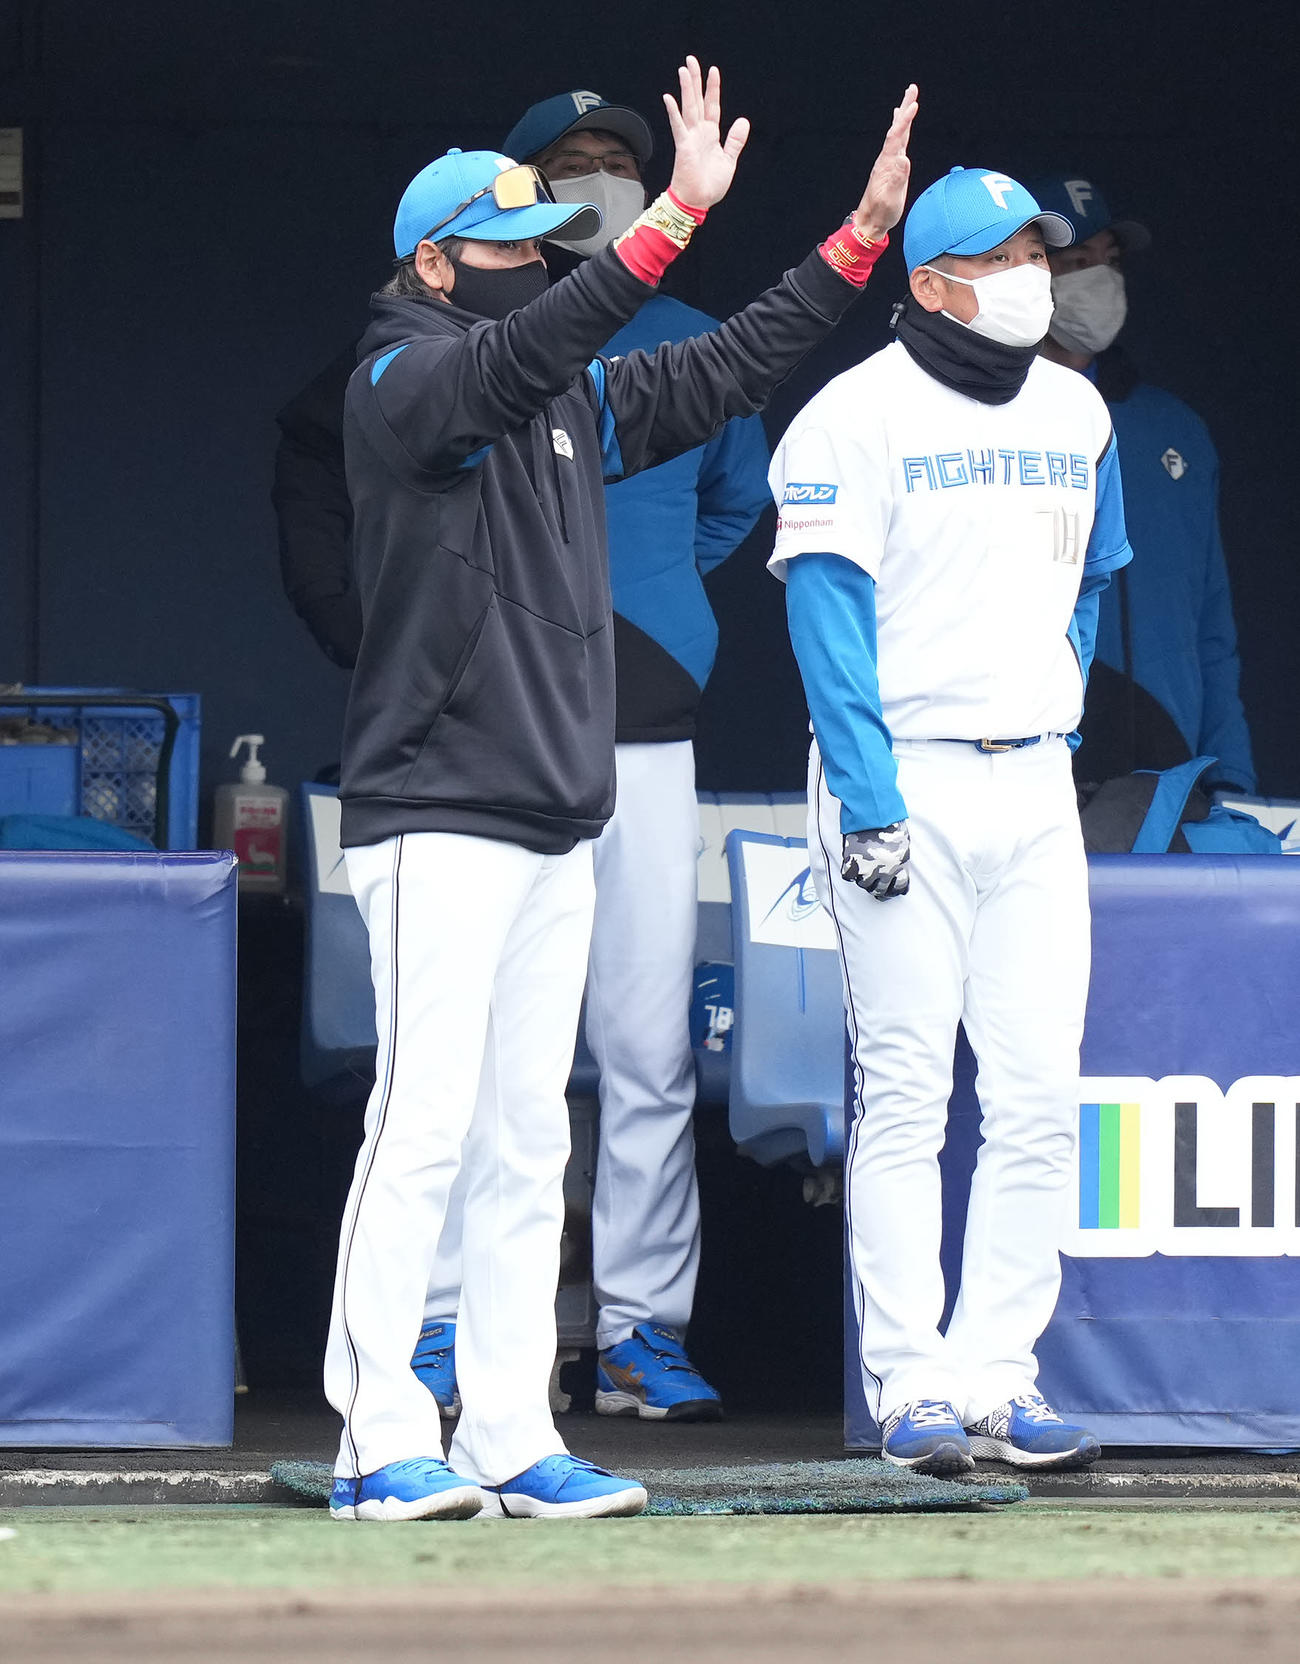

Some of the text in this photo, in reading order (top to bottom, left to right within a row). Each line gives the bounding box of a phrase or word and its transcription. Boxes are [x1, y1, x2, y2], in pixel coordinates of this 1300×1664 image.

[571, 90, 602, 115] F
[980, 173, 1014, 210] F
[1064, 180, 1093, 217] F
[903, 448, 1089, 493] FIGHTERS
[1166, 454, 1179, 474] F
[784, 485, 834, 501] ホクレン
[784, 518, 833, 531] Nipponham
[704, 1004, 734, 1032] 78
[1174, 1102, 1300, 1228] LI
